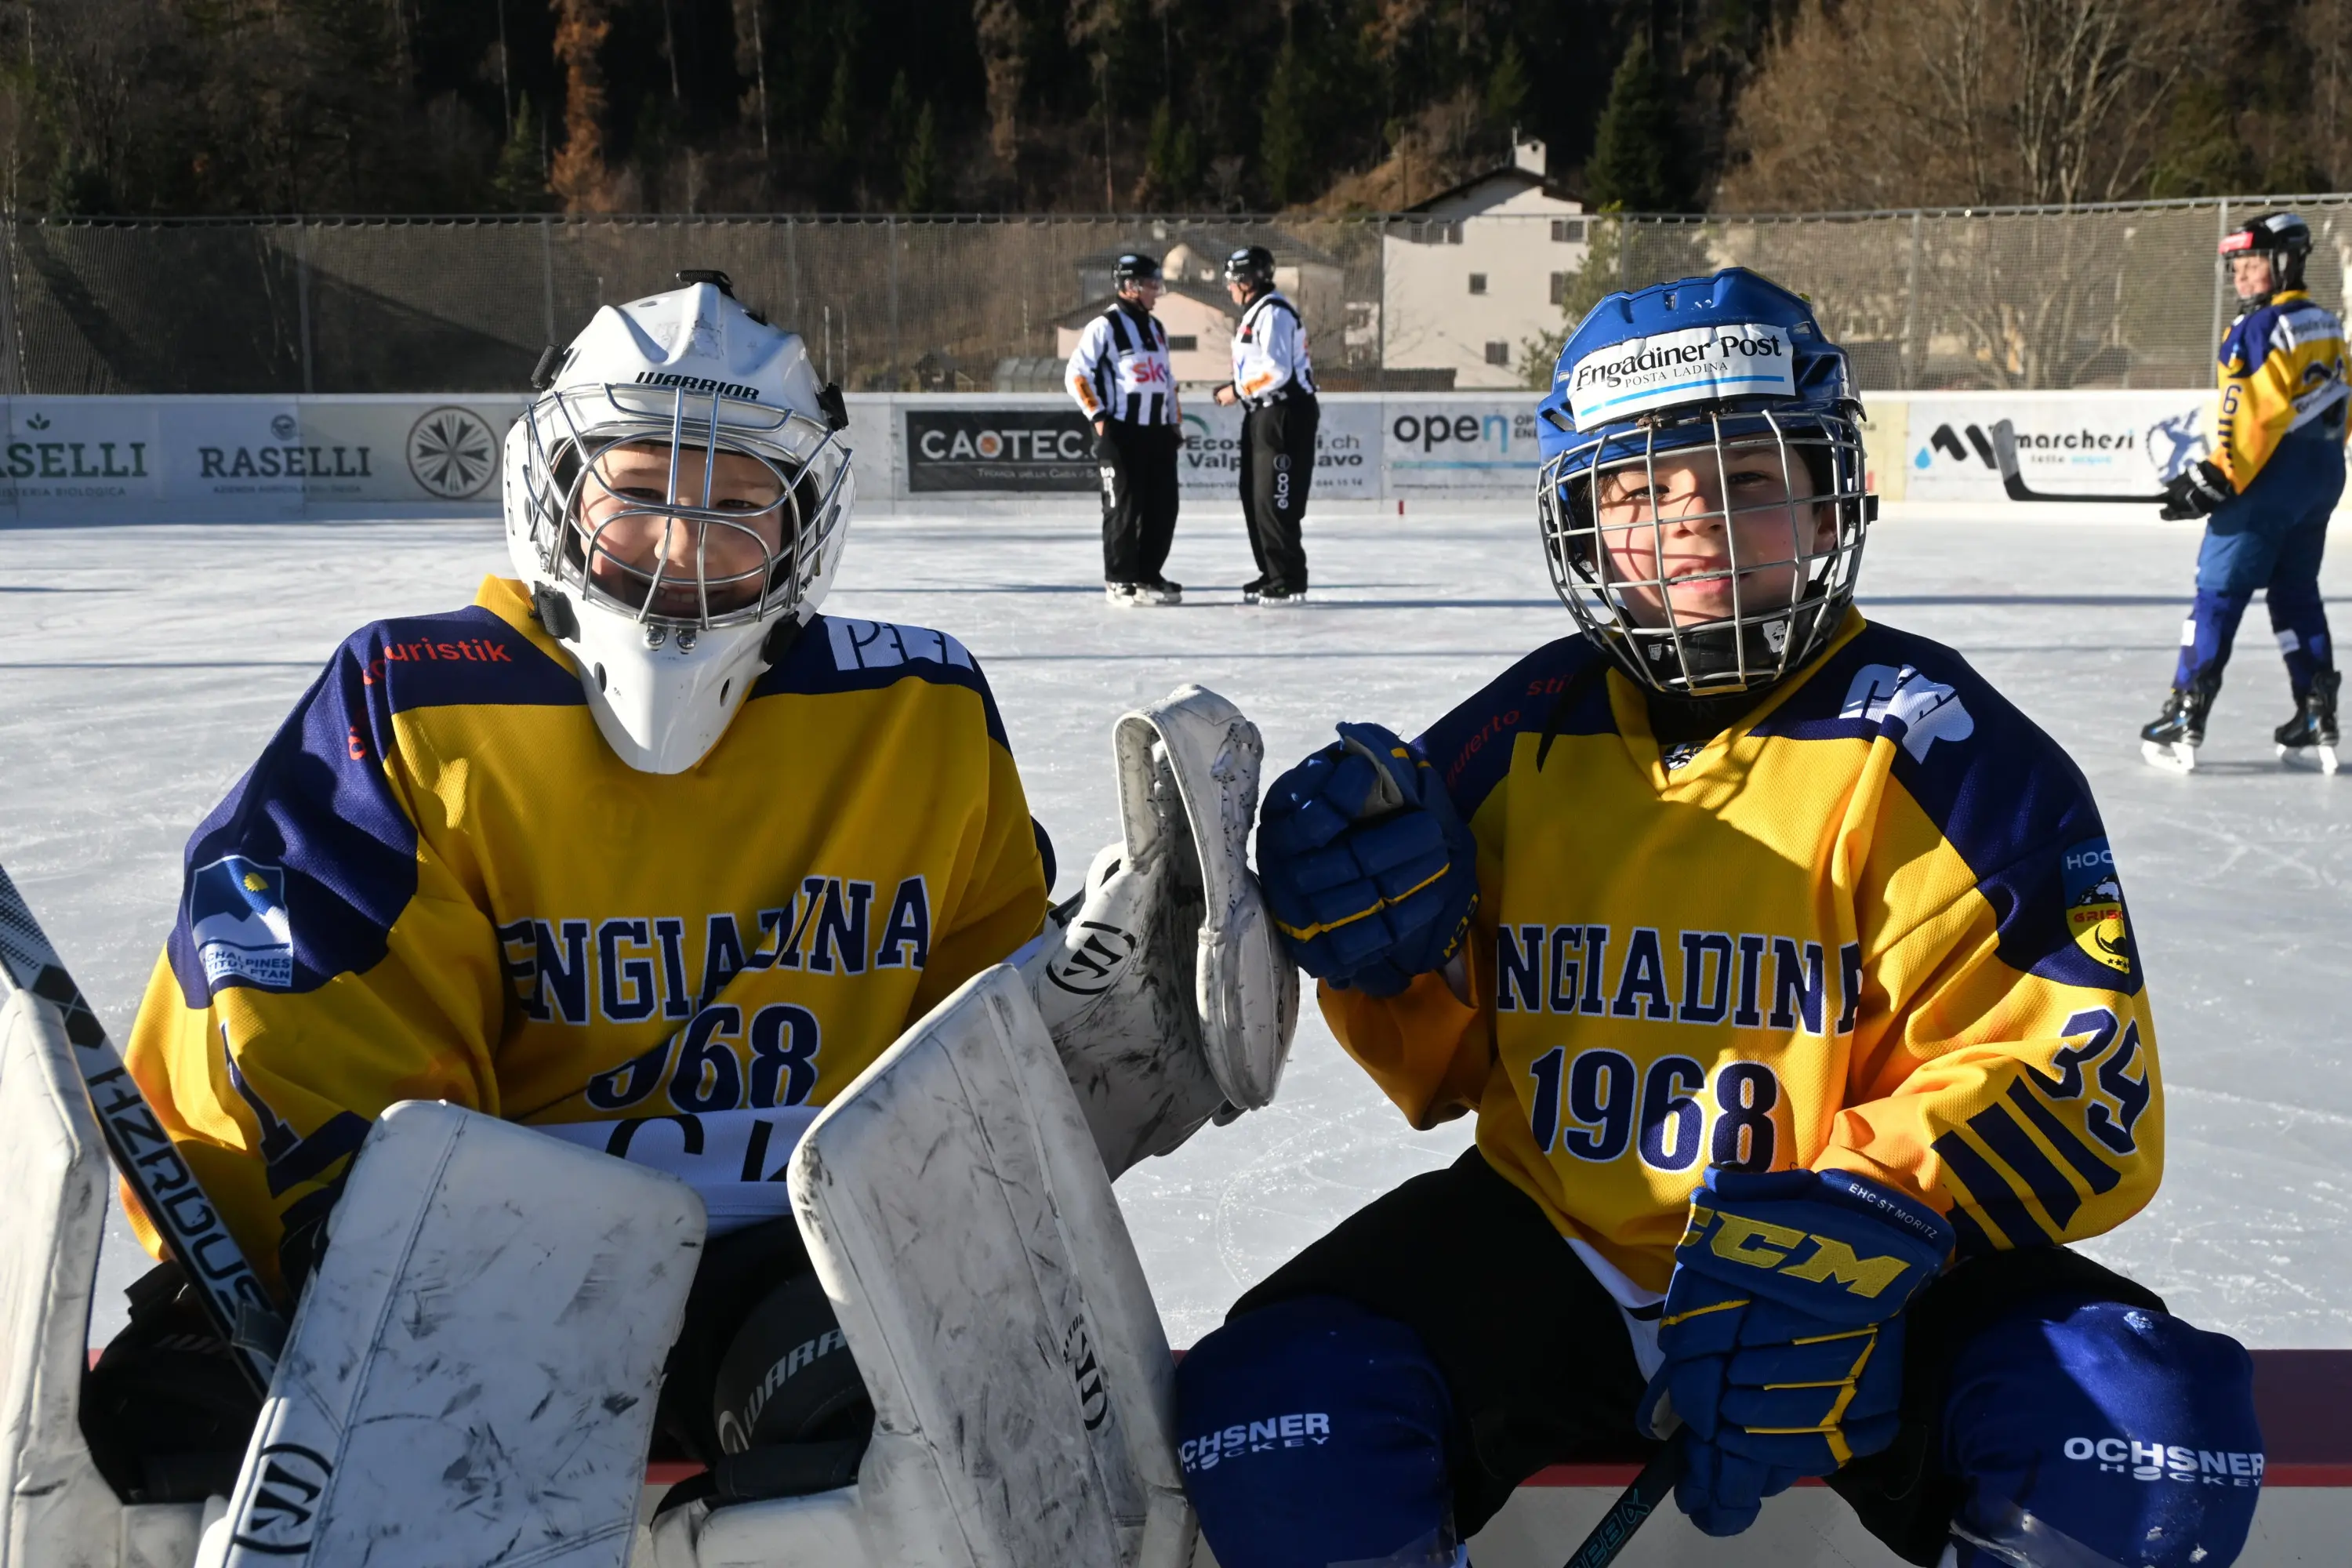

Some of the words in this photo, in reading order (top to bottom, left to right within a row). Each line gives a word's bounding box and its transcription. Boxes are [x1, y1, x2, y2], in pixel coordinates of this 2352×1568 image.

[1576, 343, 1711, 392] Engadiner
[1720, 335, 1783, 358] Post
[1625, 372, 1668, 389] POSTA
[1673, 362, 1730, 378] LADINA
[634, 371, 760, 401] WARRIOR
[2223, 385, 2242, 415] 6
[1393, 415, 1508, 453] open
[2014, 427, 2134, 449] marchesi
[0, 442, 148, 478] SELLI
[198, 446, 373, 478] RASELLI
[1274, 472, 1290, 510] elco
[2073, 908, 2124, 924] GRIS
[249, 968, 290, 980] FTAN
[1530, 1046, 1780, 1174] 1968
[1848, 1181, 1878, 1205] EHC
[1878, 1197, 1896, 1212] ST
[1893, 1207, 1940, 1240] MORITZ
[742, 1327, 848, 1439] WARR
[1178, 1413, 1330, 1466] CHSNER
[2063, 1436, 2264, 1477] OCHSNER
